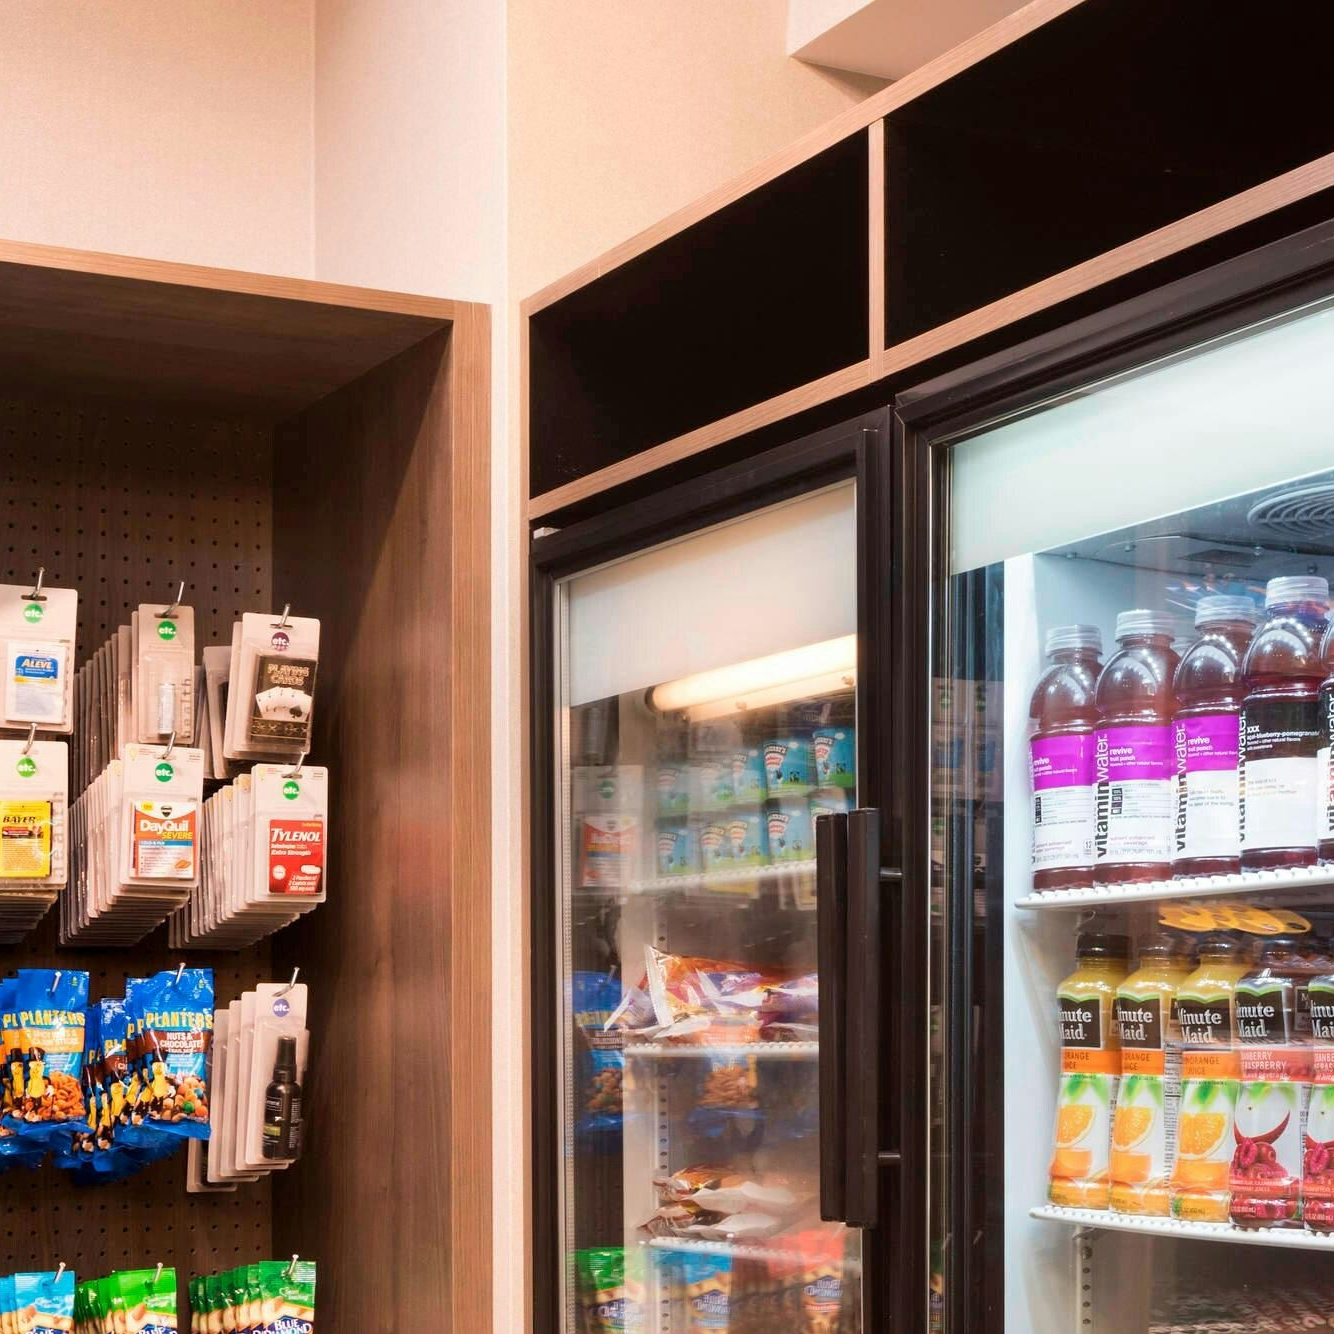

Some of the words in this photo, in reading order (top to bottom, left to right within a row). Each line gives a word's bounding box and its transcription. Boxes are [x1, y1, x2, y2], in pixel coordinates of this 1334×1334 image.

[159, 626, 176, 635] etc.
[272, 637, 290, 646] etc.
[21, 659, 53, 669] ALEVE
[267, 663, 309, 677] PLAYING
[270, 674, 304, 686] CARDS
[1247, 725, 1260, 733] xxx
[1187, 737, 1210, 745] revive
[1110, 746, 1133, 755] revive
[156, 768, 174, 777] etc.
[3, 815, 36, 824] BAYER
[140, 820, 189, 836] DayQuil
[162, 831, 193, 840] SEVERE
[271, 828, 321, 842] TYLENOL
[20, 1010, 85, 1026] PLANTERS
[146, 1012, 212, 1029] PLANTERS
[274, 1318, 299, 1331] BLUE
